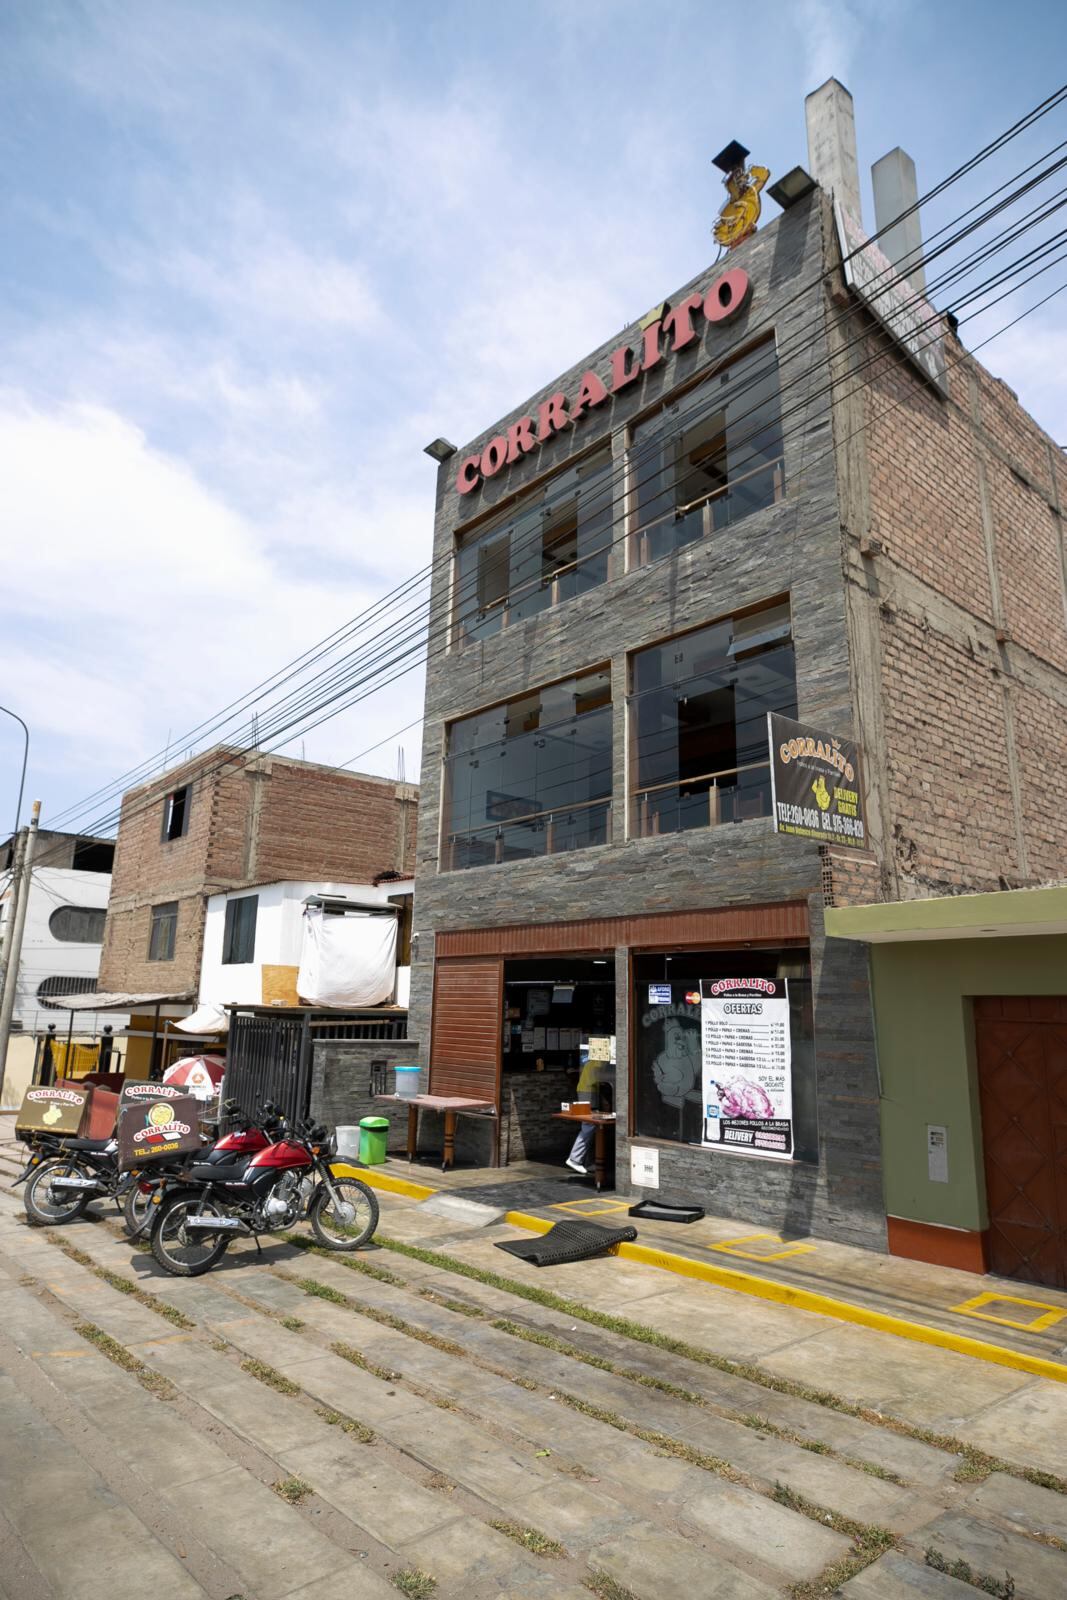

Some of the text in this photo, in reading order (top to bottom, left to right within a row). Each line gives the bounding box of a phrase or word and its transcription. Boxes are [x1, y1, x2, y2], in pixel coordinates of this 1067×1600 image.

[456, 267, 749, 496] CORRALITO
[780, 737, 854, 782] CORRALITO
[834, 787, 858, 805] DELIVERY
[711, 978, 776, 995] CORRALITO
[723, 1003, 763, 1015] OFERTAS
[27, 1089, 84, 1105] CORRALITO
[125, 1085, 183, 1098] CORRALIT
[133, 1122, 191, 1142] CORRALITO
[724, 1130, 754, 1143] DELIVERY
